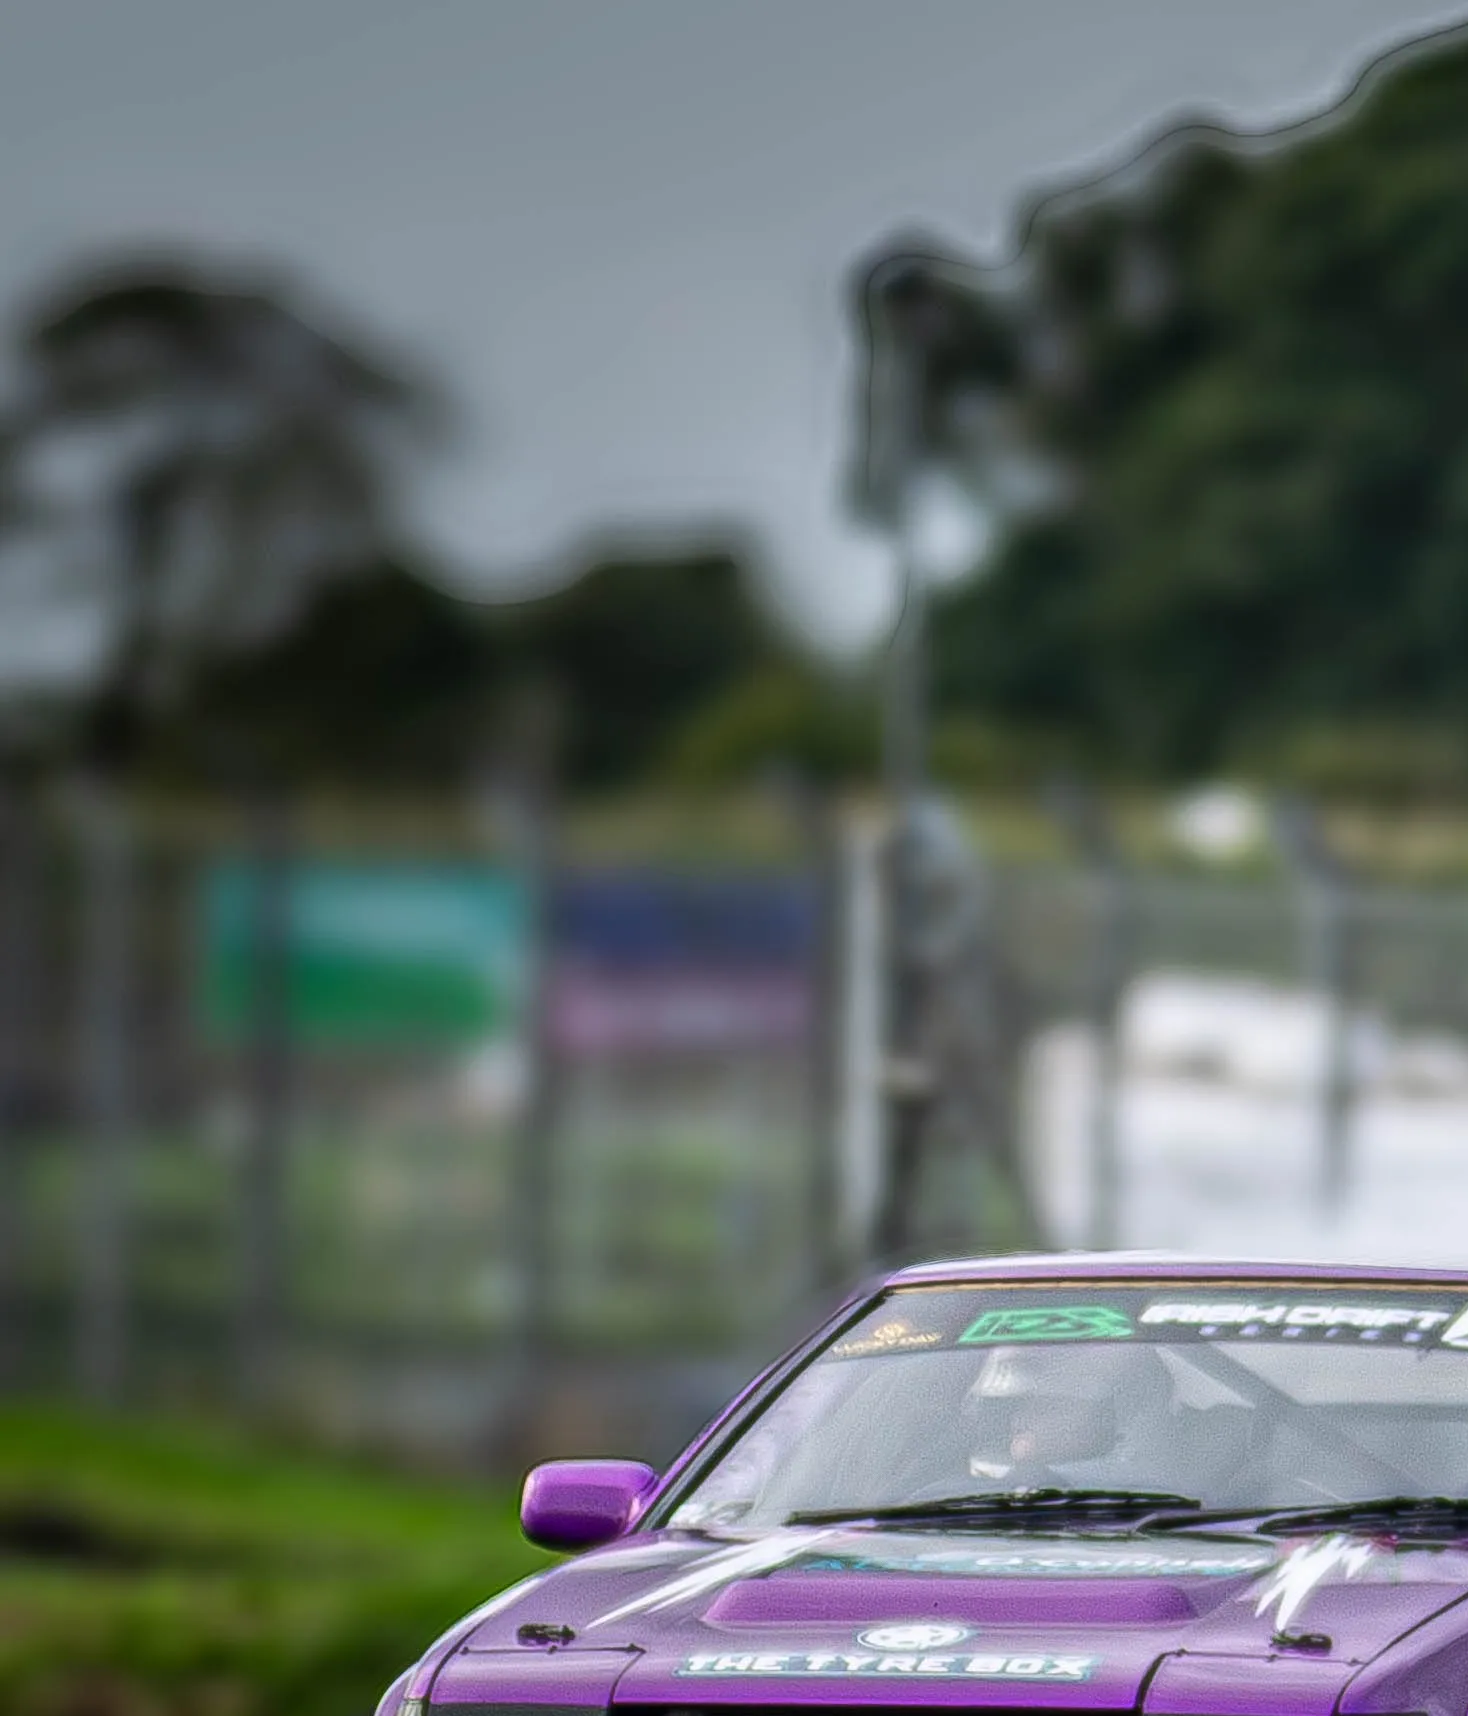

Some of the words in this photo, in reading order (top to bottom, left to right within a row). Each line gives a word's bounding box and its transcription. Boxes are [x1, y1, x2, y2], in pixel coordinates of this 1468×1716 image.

[1285, 1306, 1450, 1328] DRIFT
[686, 1655, 789, 1673] THE
[804, 1656, 956, 1674] TYRE
[964, 1657, 1092, 1677] BOX
